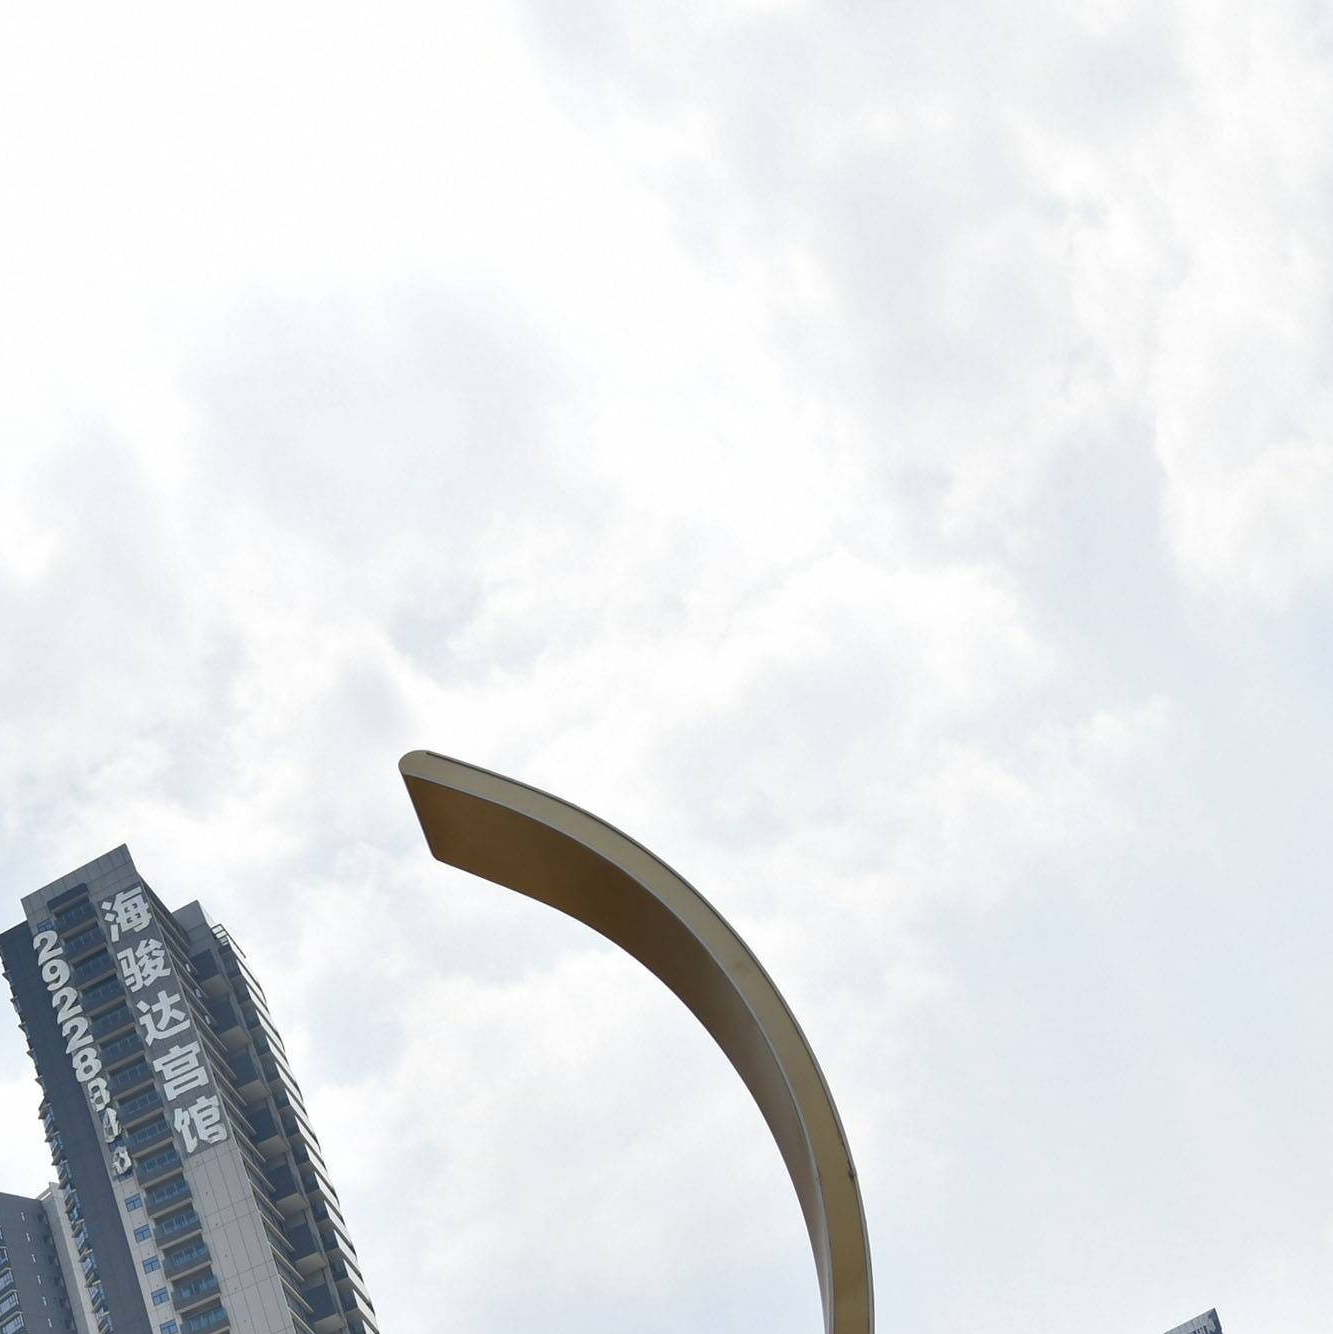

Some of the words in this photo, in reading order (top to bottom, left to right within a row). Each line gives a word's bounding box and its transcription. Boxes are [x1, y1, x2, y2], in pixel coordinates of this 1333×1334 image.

[101, 886, 228, 1154] 海骏达宫馆
